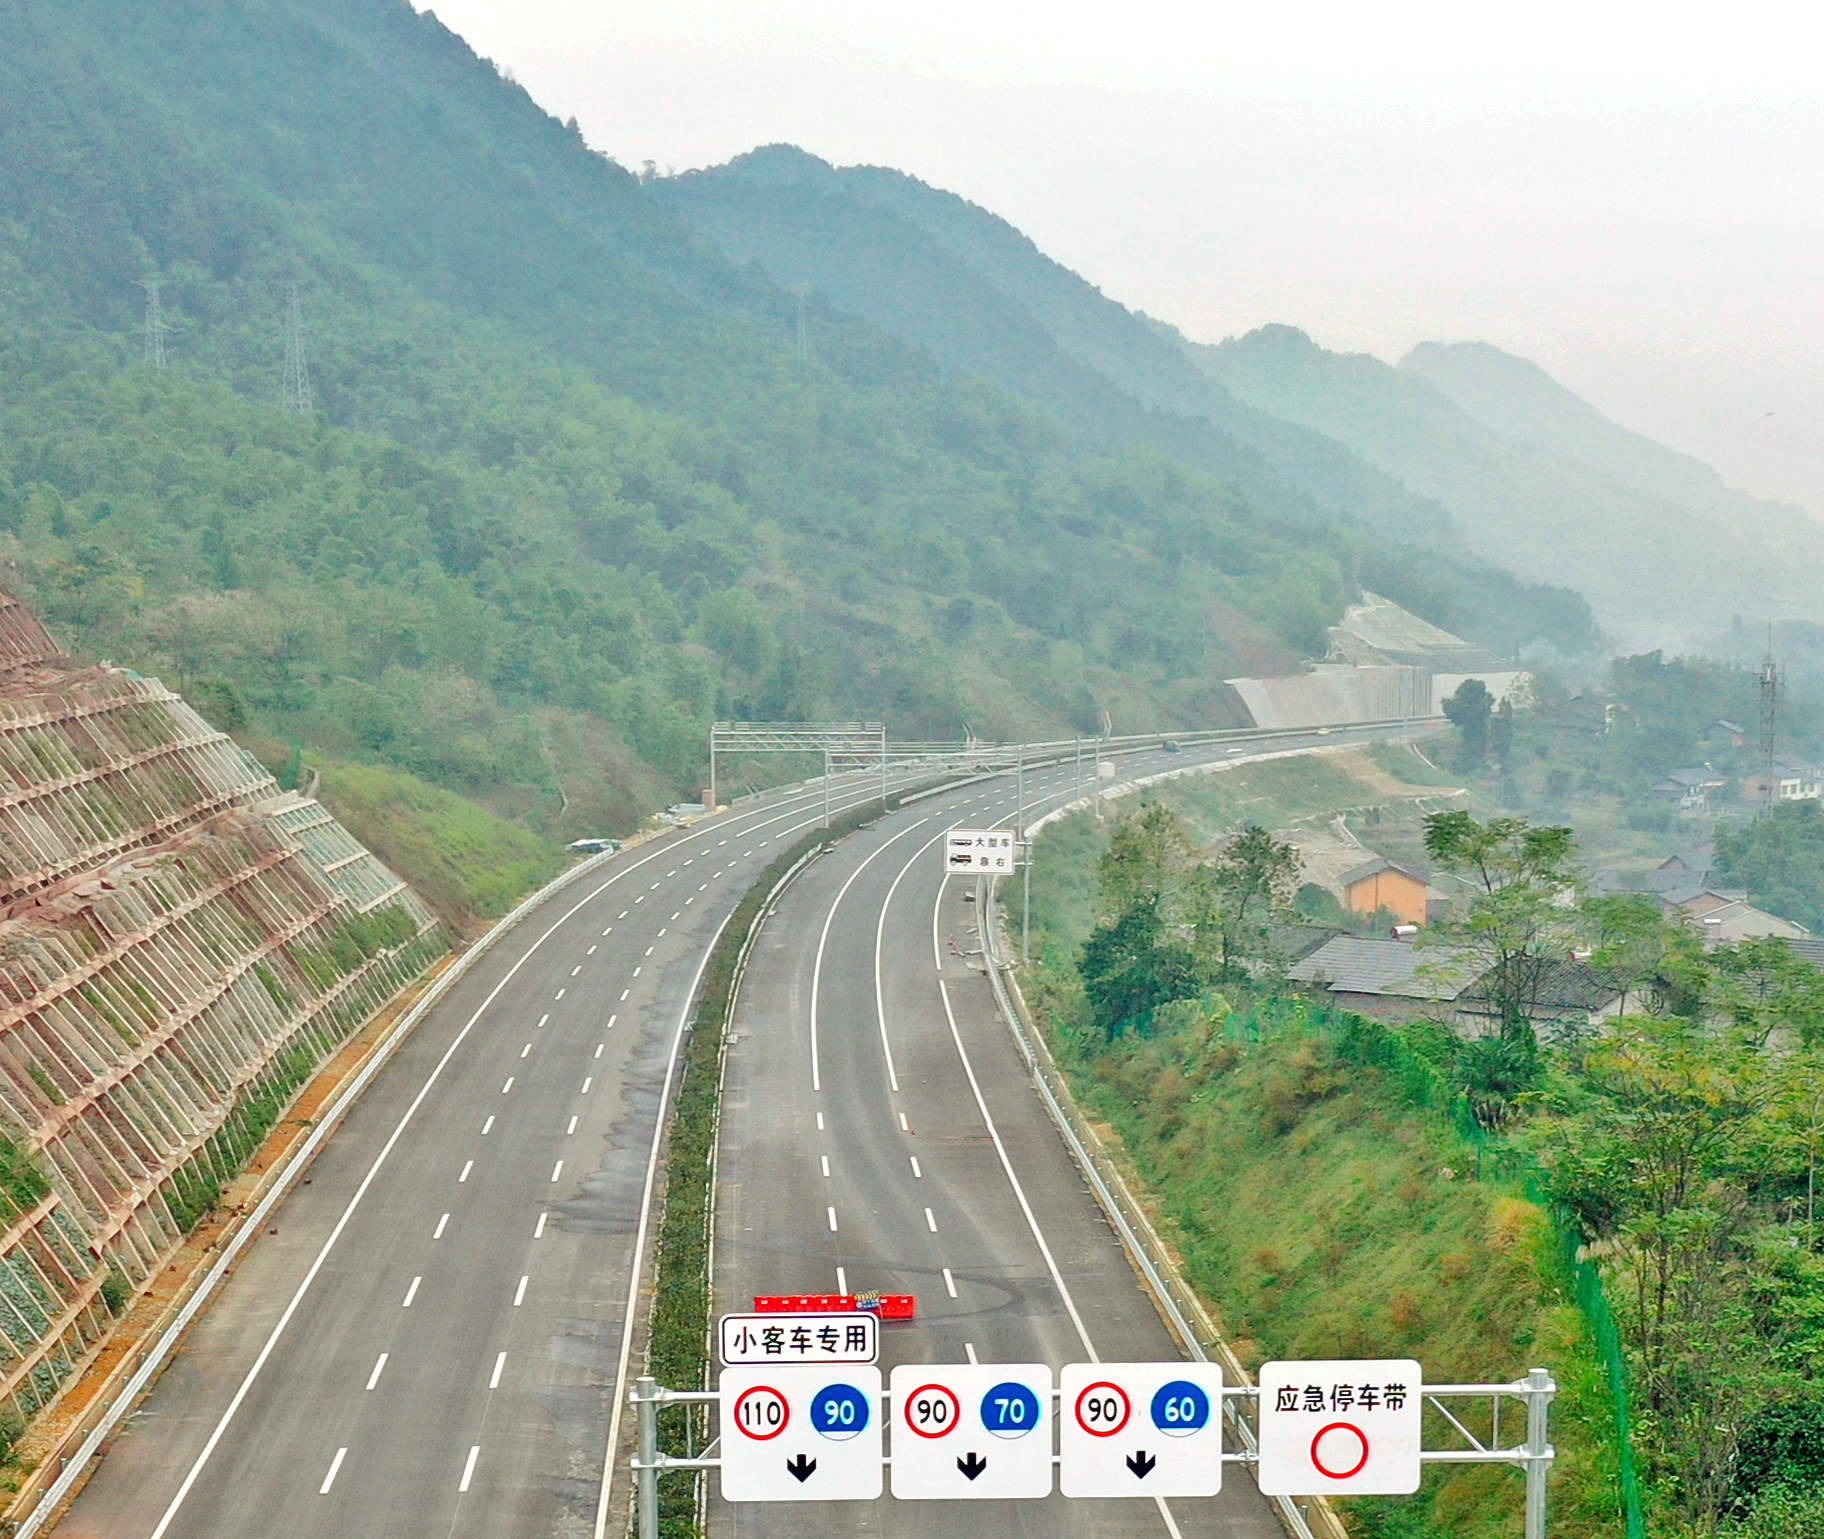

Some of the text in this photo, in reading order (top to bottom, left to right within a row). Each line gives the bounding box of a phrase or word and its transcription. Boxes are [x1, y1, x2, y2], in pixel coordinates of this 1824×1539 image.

[733, 1325, 867, 1354] 小客车专用
[1088, 1397, 1118, 1422] 90
[1165, 1396, 1195, 1422] 60
[1274, 1383, 1407, 1413] 应急停车带
[743, 1401, 781, 1426] 110
[825, 1400, 854, 1425] 90
[917, 1399, 947, 1424] 90
[994, 1398, 1024, 1424] 70
